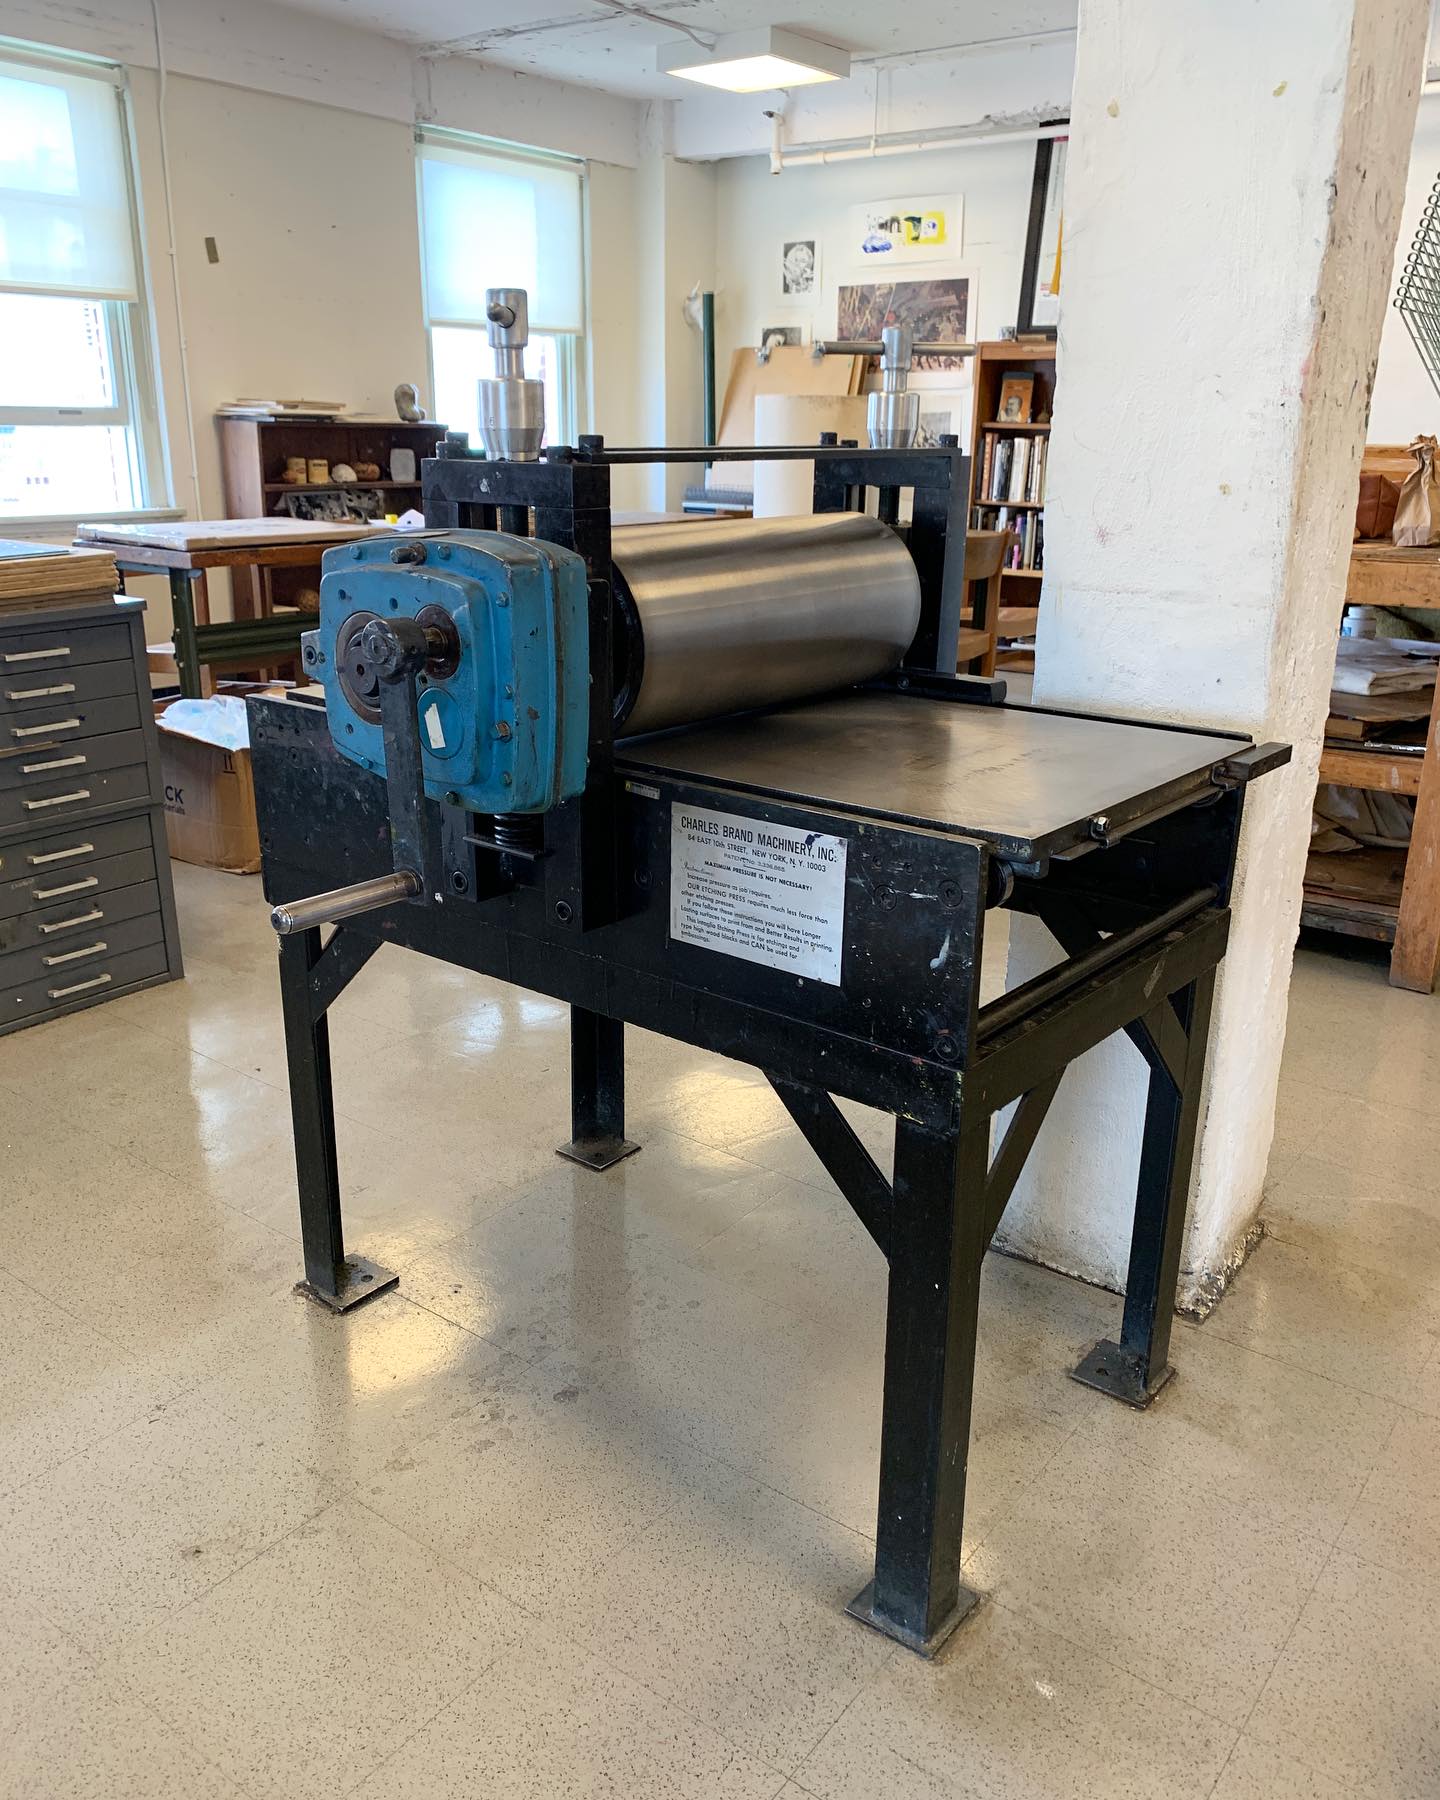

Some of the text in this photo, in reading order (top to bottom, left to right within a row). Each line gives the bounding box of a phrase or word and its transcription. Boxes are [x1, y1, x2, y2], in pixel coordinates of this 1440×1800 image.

[681, 816, 718, 835] CHARLES
[723, 825, 753, 843] BRAND
[757, 833, 815, 859] MACHINERY,
[688, 833, 695, 841] 84
[697, 836, 711, 845] EAST
[752, 849, 767, 858] NEW
[807, 862, 826, 872] 10003
[687, 872, 708, 883] Increase
[709, 879, 731, 889] pressure
[704, 860, 731, 871] MAXIMUM
[732, 867, 757, 878] PRESSURE
[687, 882, 829, 924] OUR ETCHING PRESS requires much less force than
[696, 894, 714, 903] etching
[681, 904, 698, 915] Lasting
[700, 911, 720, 920] surfaces
[741, 921, 753, 929] from
[766, 928, 782, 938] Better
[784, 932, 802, 944] Results
[687, 915, 696, 923] This
[697, 919, 716, 929] Intaglio
[717, 923, 735, 935] Etching
[736, 929, 750, 938] Press
[756, 934, 765, 942] for
[766, 938, 787, 949] etchings
[788, 944, 800, 952] and
[703, 902, 718, 911] follow
[719, 907, 733, 916] these
[734, 913, 763, 925] instructions
[765, 920, 775, 928] you
[787, 925, 800, 934] have
[802, 929, 821, 940] Longer
[681, 922, 692, 930] type
[693, 925, 704, 933] high
[721, 933, 738, 942] blocks
[751, 941, 765, 951] CAN
[775, 949, 788, 957] used
[789, 951, 798, 960] for
